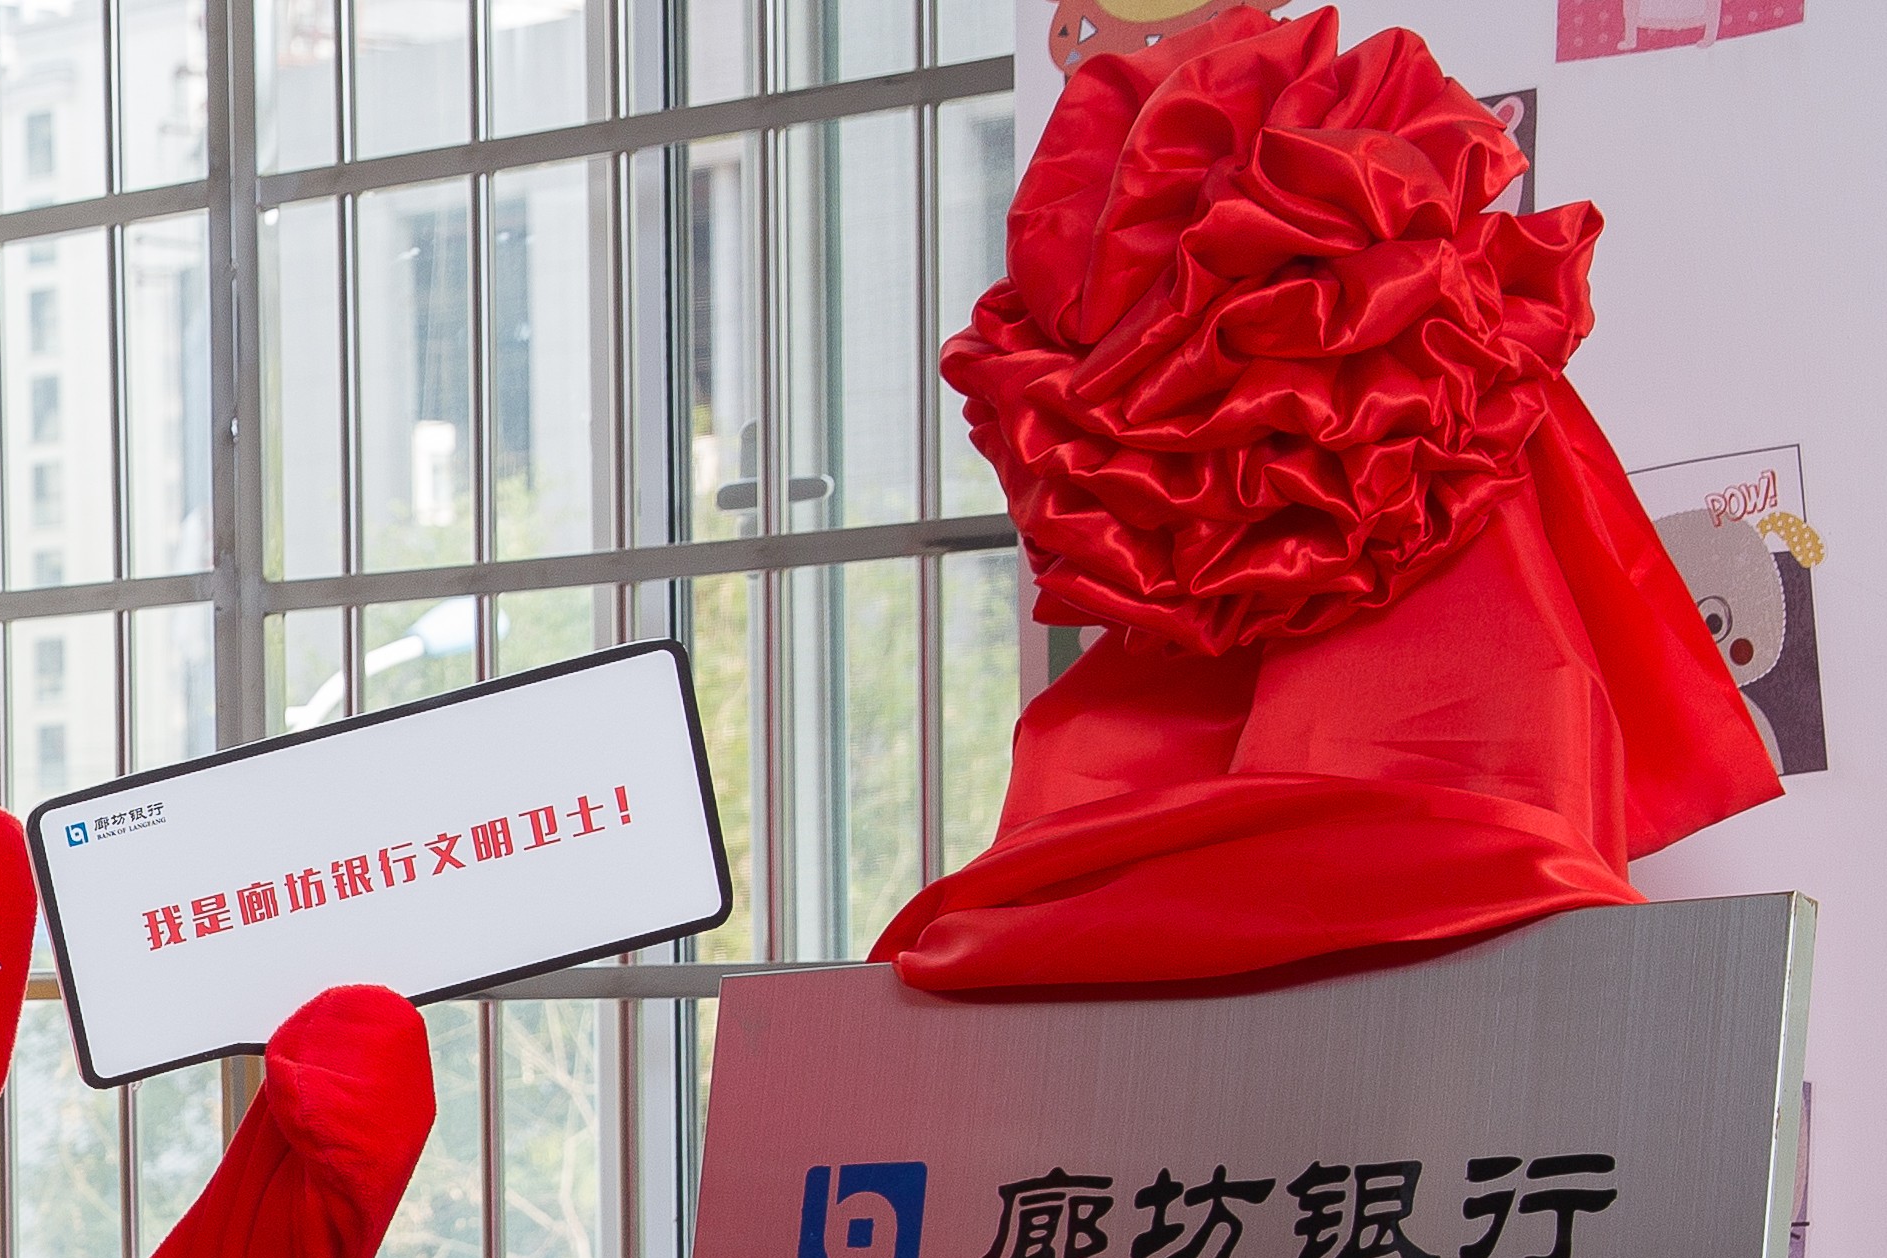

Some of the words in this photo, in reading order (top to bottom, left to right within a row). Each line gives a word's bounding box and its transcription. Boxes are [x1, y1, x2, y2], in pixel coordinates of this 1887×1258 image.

[1704, 469, 1778, 528] POW!
[94, 802, 164, 831] 廊坊银行
[97, 830, 116, 840] BANK
[117, 827, 127, 835] OF
[129, 817, 167, 832] LANGFANG
[141, 785, 633, 952] 我是廊坊银行文明卫士！
